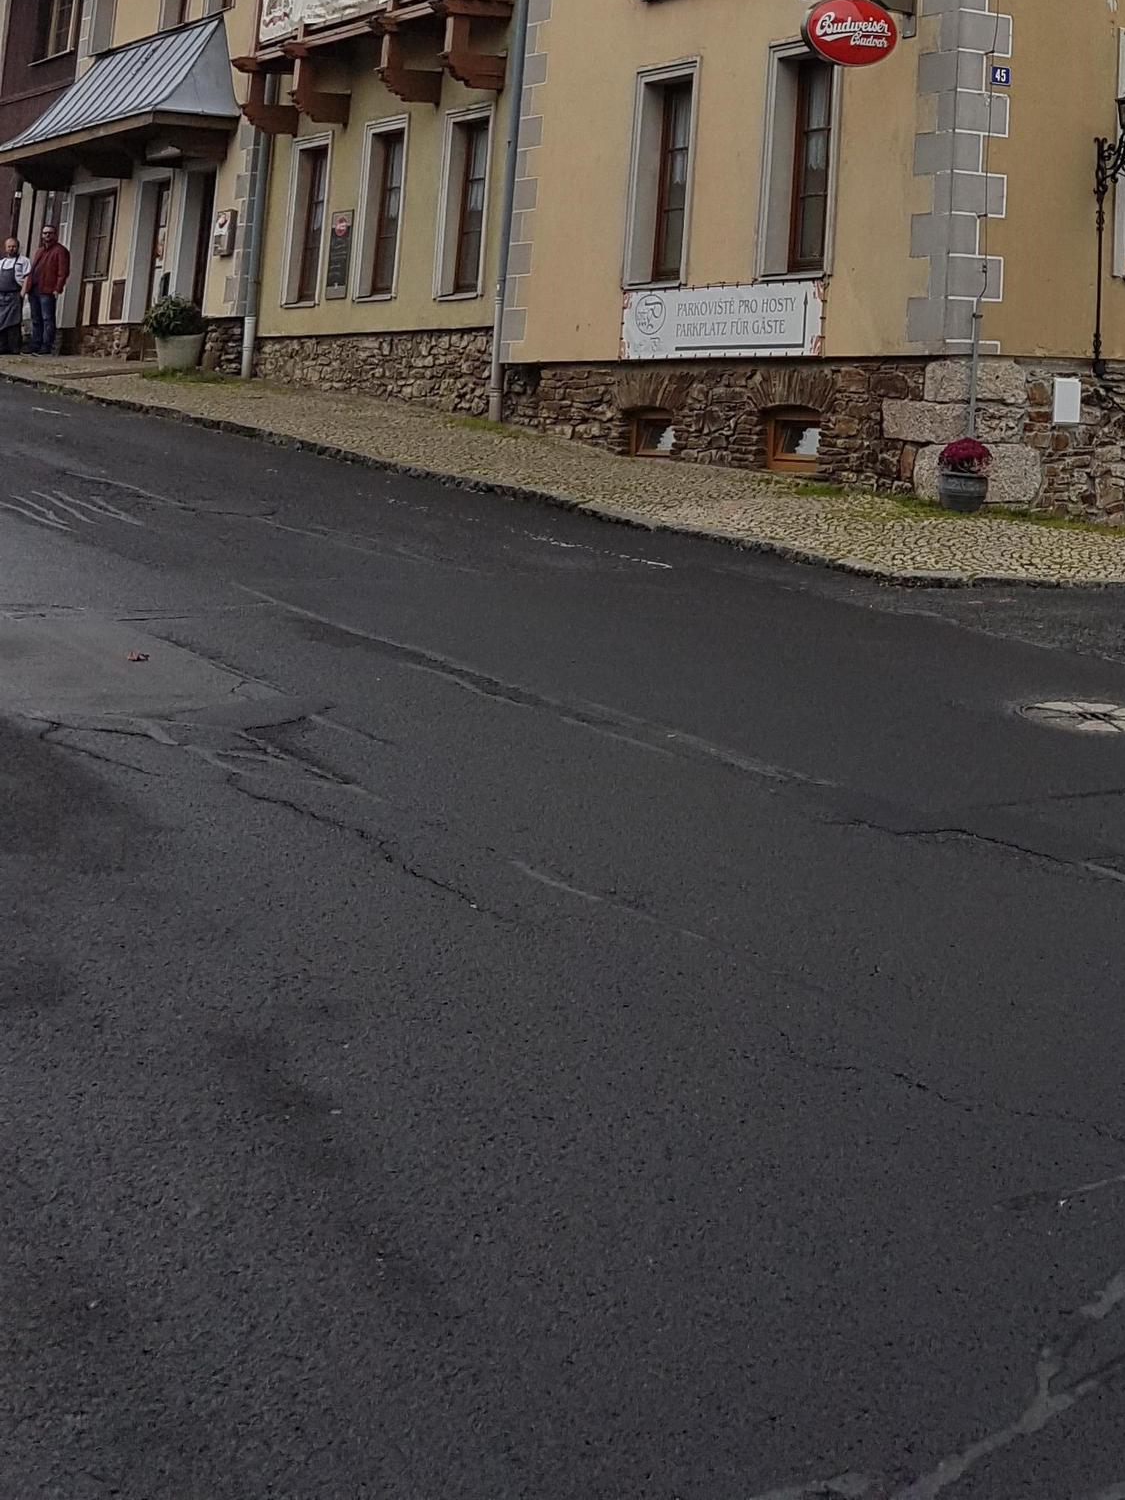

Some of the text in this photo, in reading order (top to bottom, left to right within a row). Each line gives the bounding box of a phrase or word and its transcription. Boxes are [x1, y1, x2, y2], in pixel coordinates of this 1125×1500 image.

[815, 11, 891, 40] Budweiser
[850, 32, 889, 48] Budvar
[994, 68, 1007, 83] 45
[676, 297, 735, 317] PARKOVIŠTĚ
[738, 298, 758, 314] PRO
[761, 297, 797, 313] HOSTY
[675, 317, 786, 338] PARKPLATZ FÜR GÄSTE
